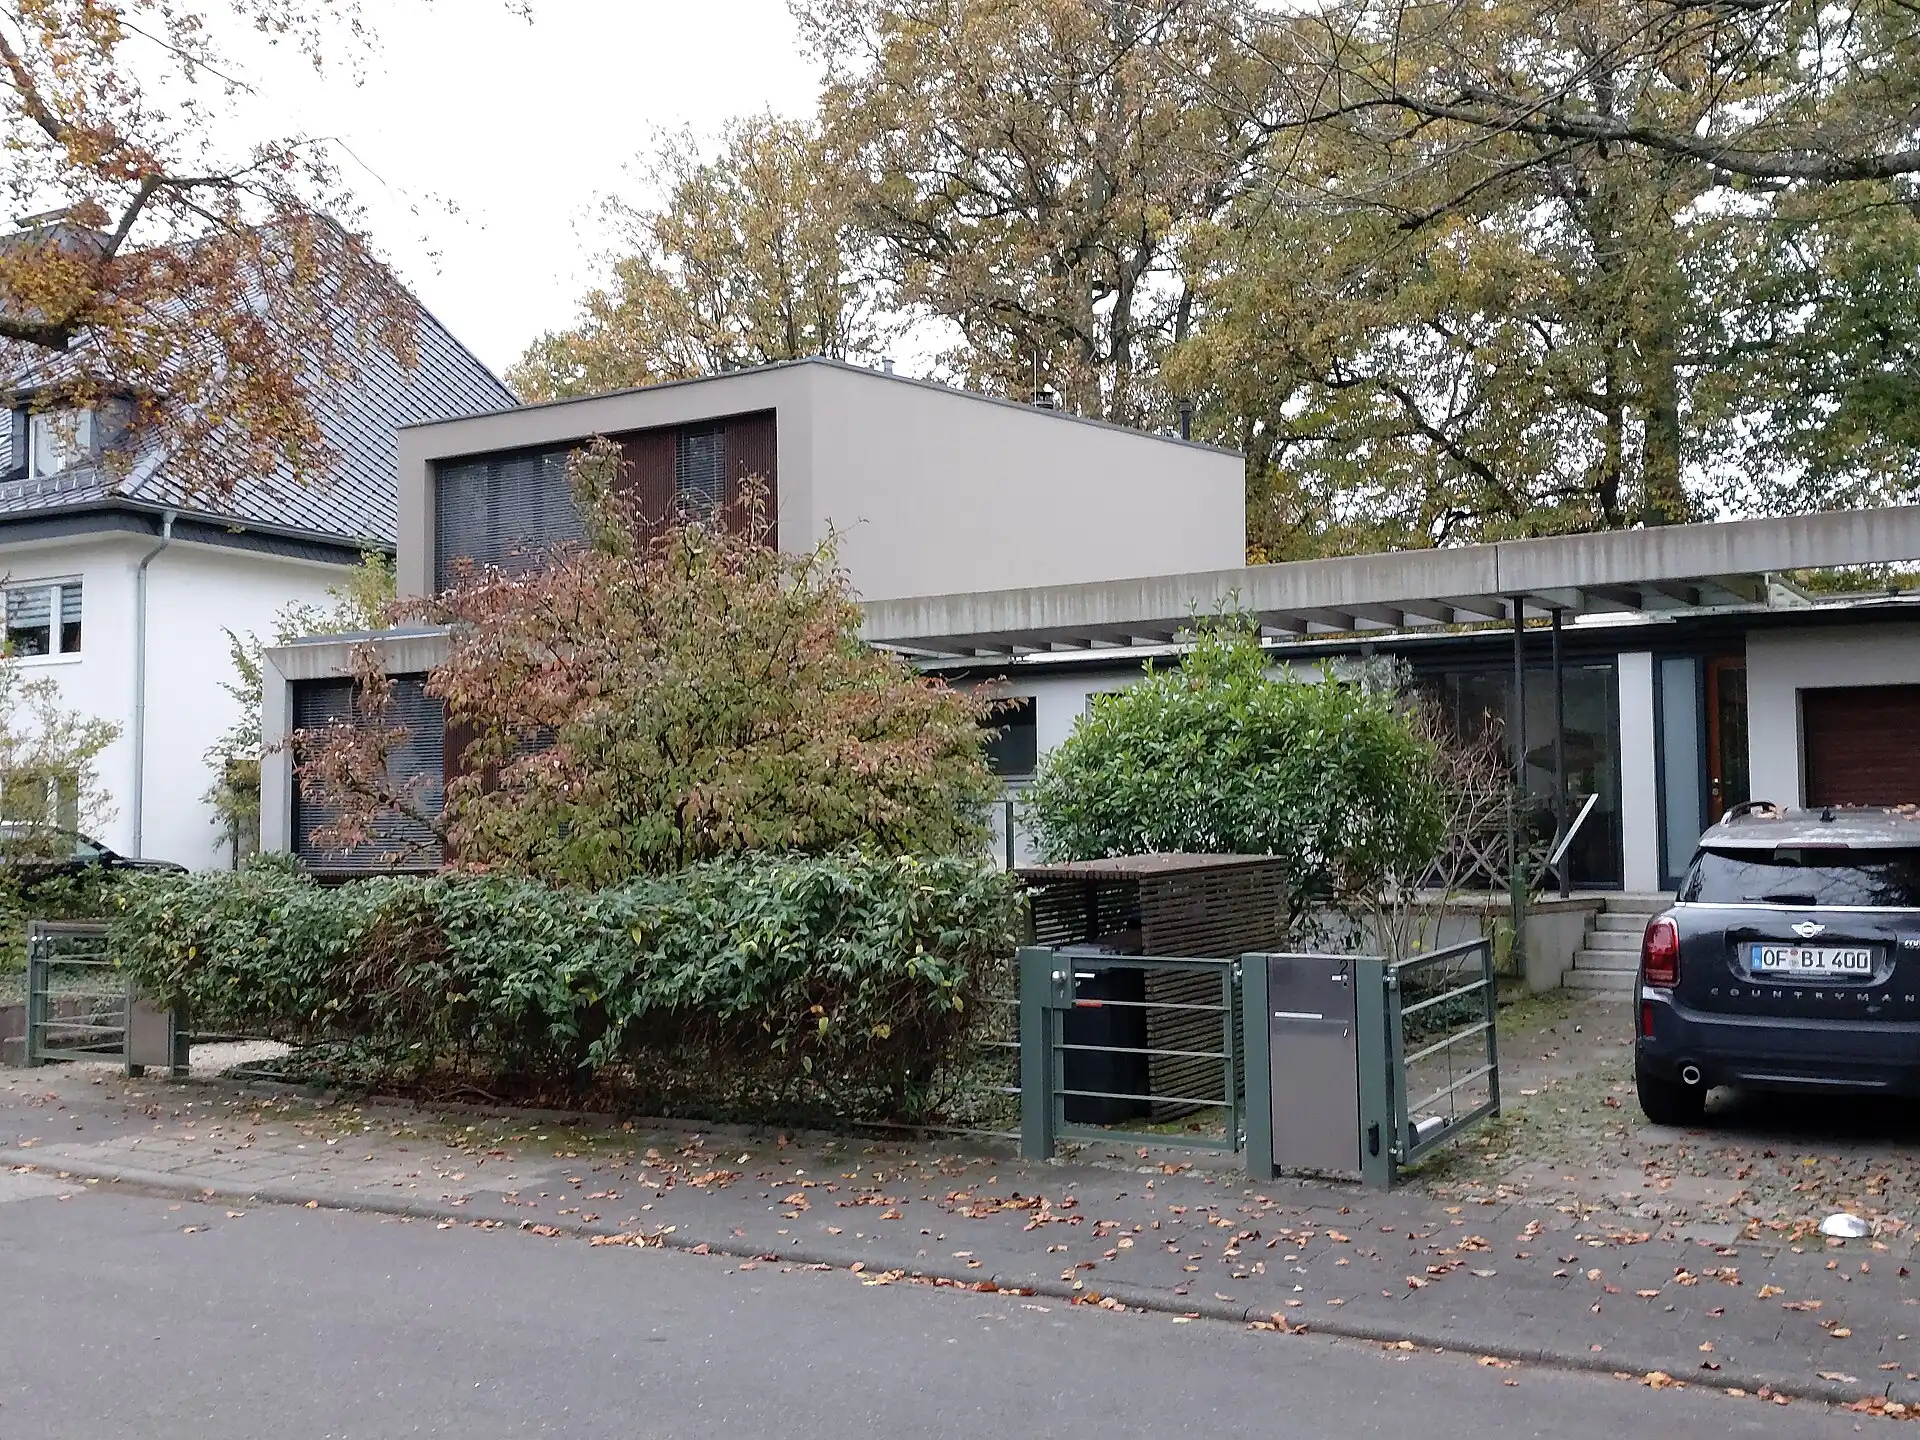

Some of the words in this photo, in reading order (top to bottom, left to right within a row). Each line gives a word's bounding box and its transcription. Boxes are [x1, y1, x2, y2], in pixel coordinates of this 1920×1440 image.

[1763, 949, 1788, 967] OF
[1801, 950, 1825, 968] BI
[1831, 951, 1869, 969] 400
[1710, 987, 1916, 1003] COUNTRYMAN
